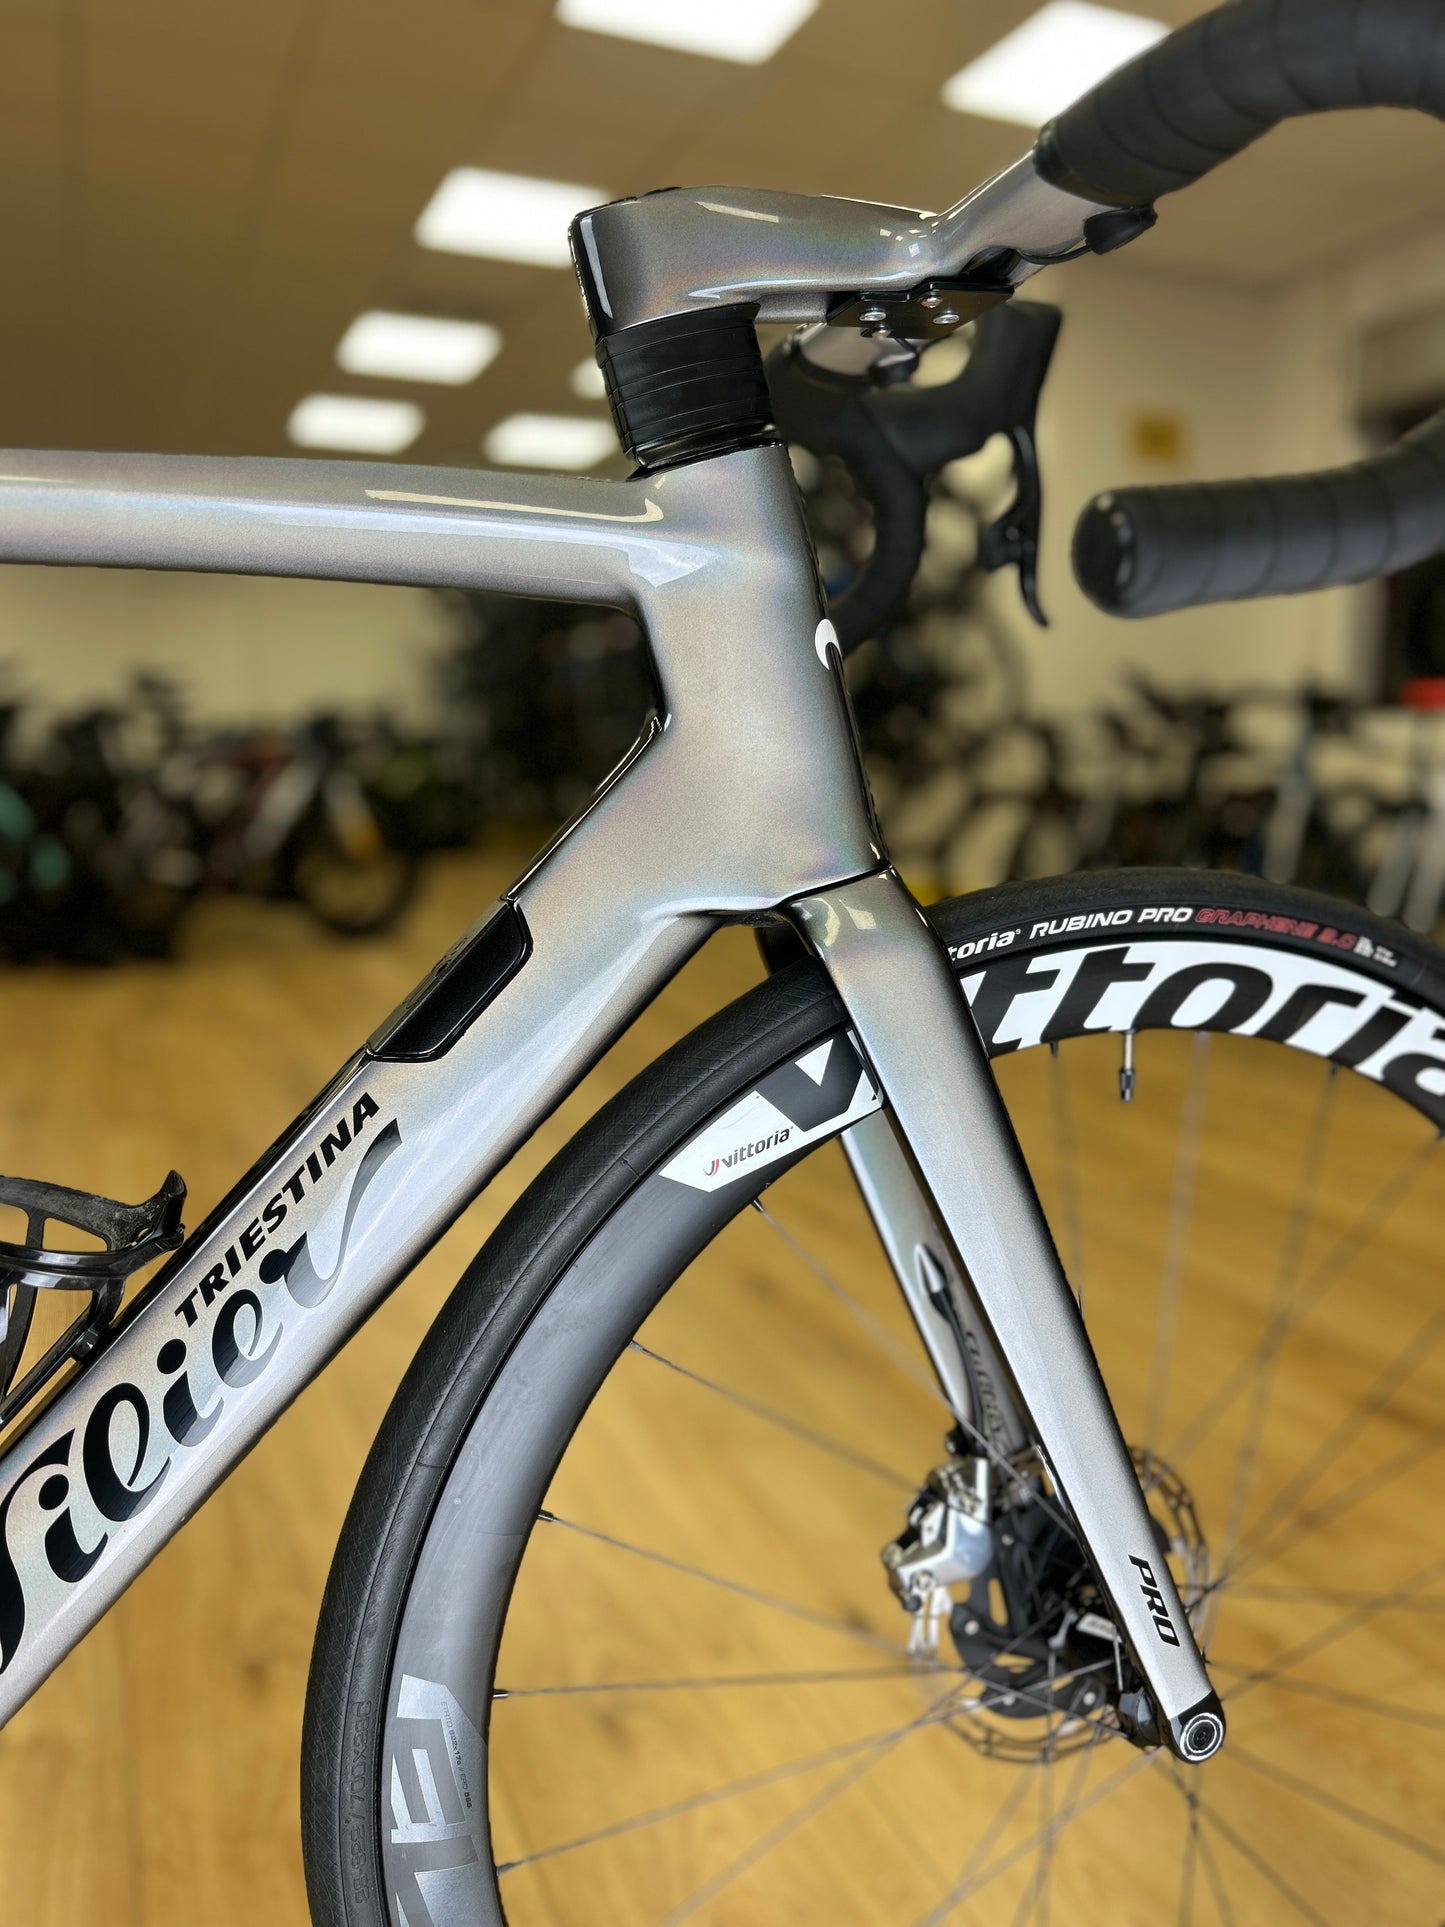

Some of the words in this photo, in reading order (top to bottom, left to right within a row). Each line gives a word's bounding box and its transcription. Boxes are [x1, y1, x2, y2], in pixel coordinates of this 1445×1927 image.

[1029, 910, 1133, 940] RUBINO
[1137, 907, 1193, 923] PRO
[721, 1126, 791, 1168] vittoria
[174, 1091, 380, 1328] TRIESTINA
[1128, 1554, 1180, 1647] PRO
